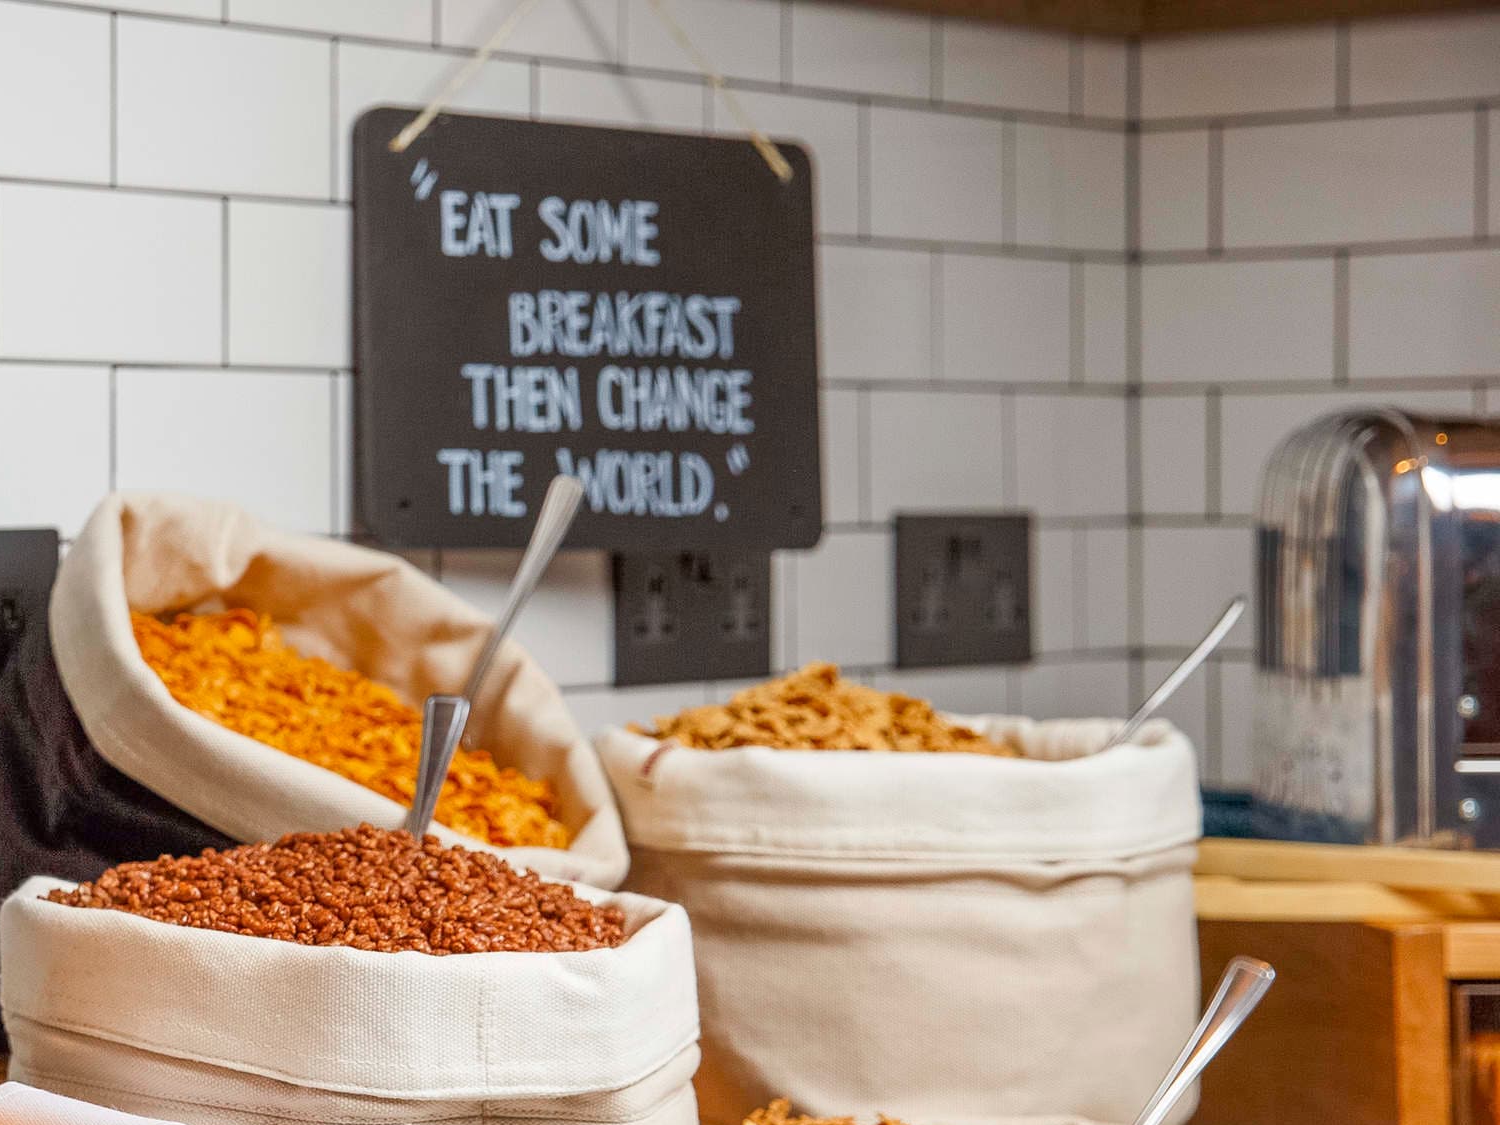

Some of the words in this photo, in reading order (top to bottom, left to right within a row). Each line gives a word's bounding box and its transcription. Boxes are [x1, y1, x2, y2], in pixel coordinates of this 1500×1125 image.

[538, 196, 660, 266] SOME
[508, 290, 742, 359] BREAKFAST
[460, 363, 582, 433] THEN
[597, 365, 755, 434] CHANGE
[436, 448, 528, 518] THE
